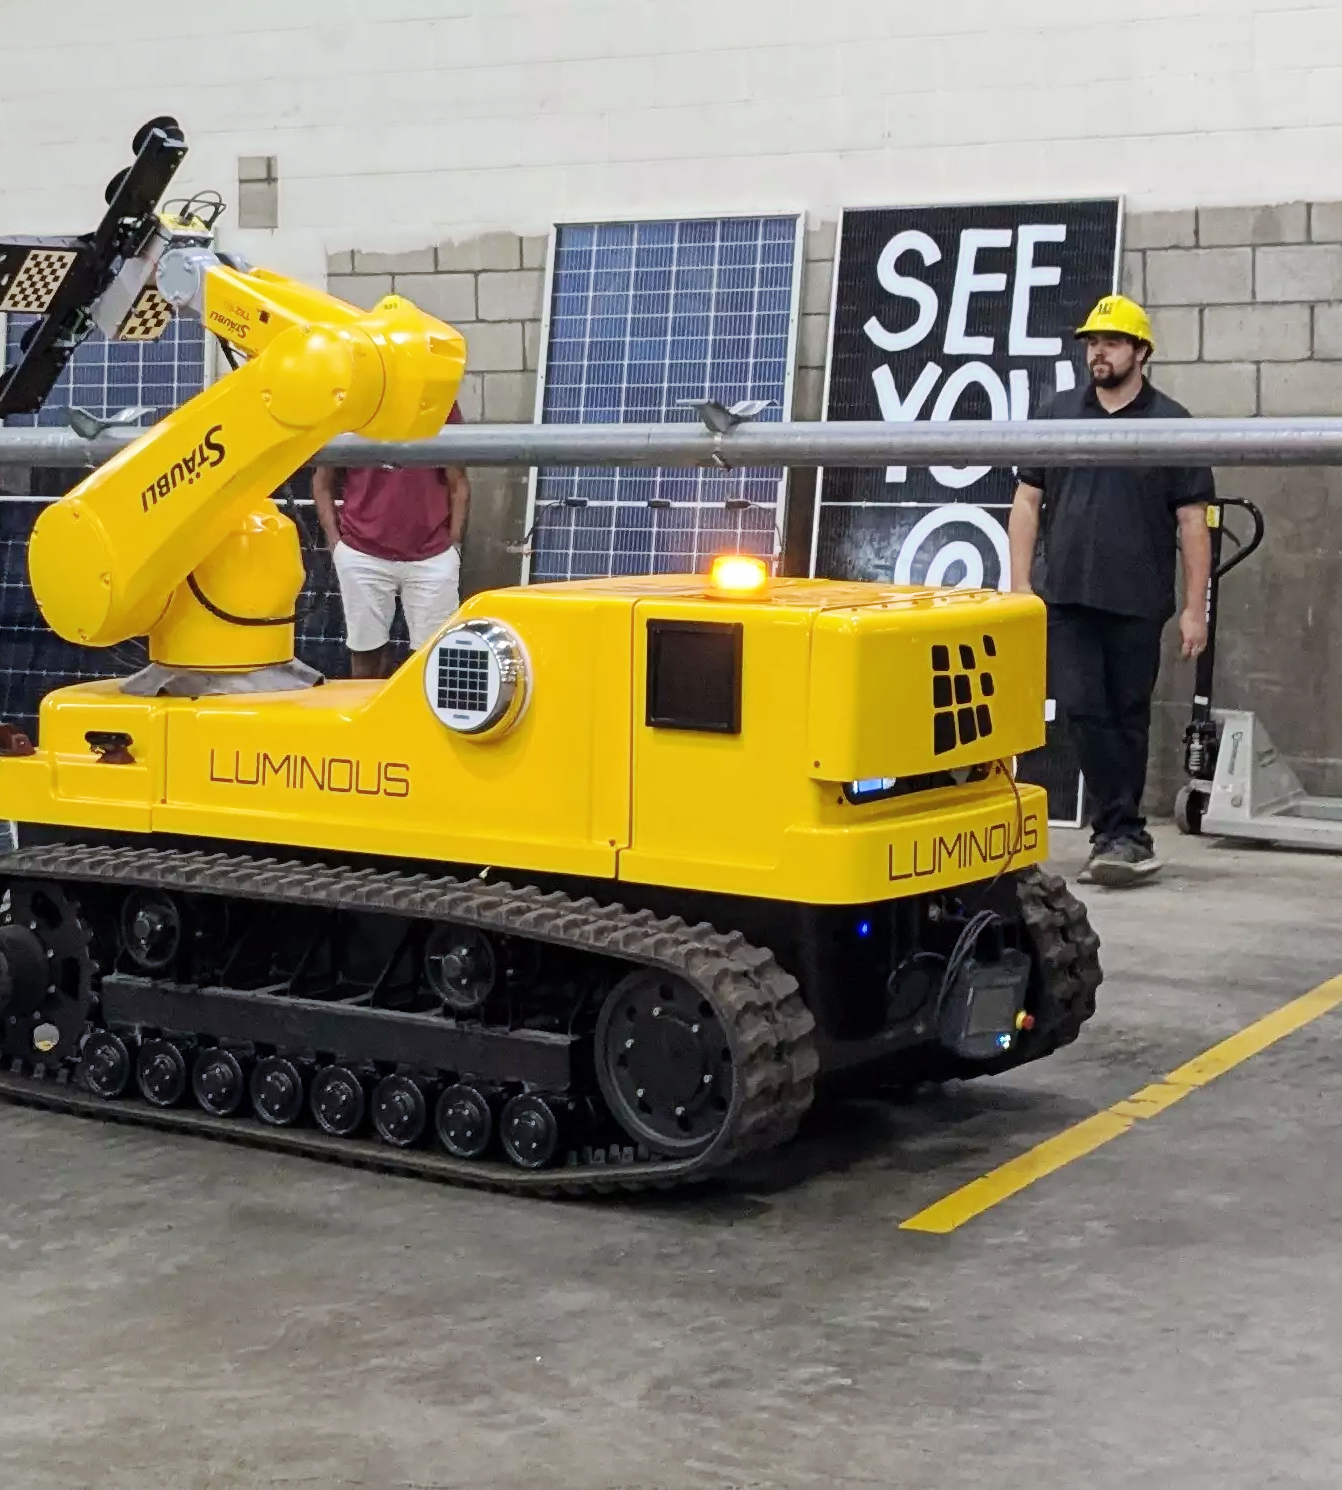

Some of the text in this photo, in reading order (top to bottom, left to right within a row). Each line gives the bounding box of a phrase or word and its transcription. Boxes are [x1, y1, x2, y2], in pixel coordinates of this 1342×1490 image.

[863, 224, 1067, 356] SEE
[141, 424, 226, 513] STÄUBLI
[210, 748, 410, 798] LUMINOUS
[888, 813, 1038, 882] LUMINOUS
